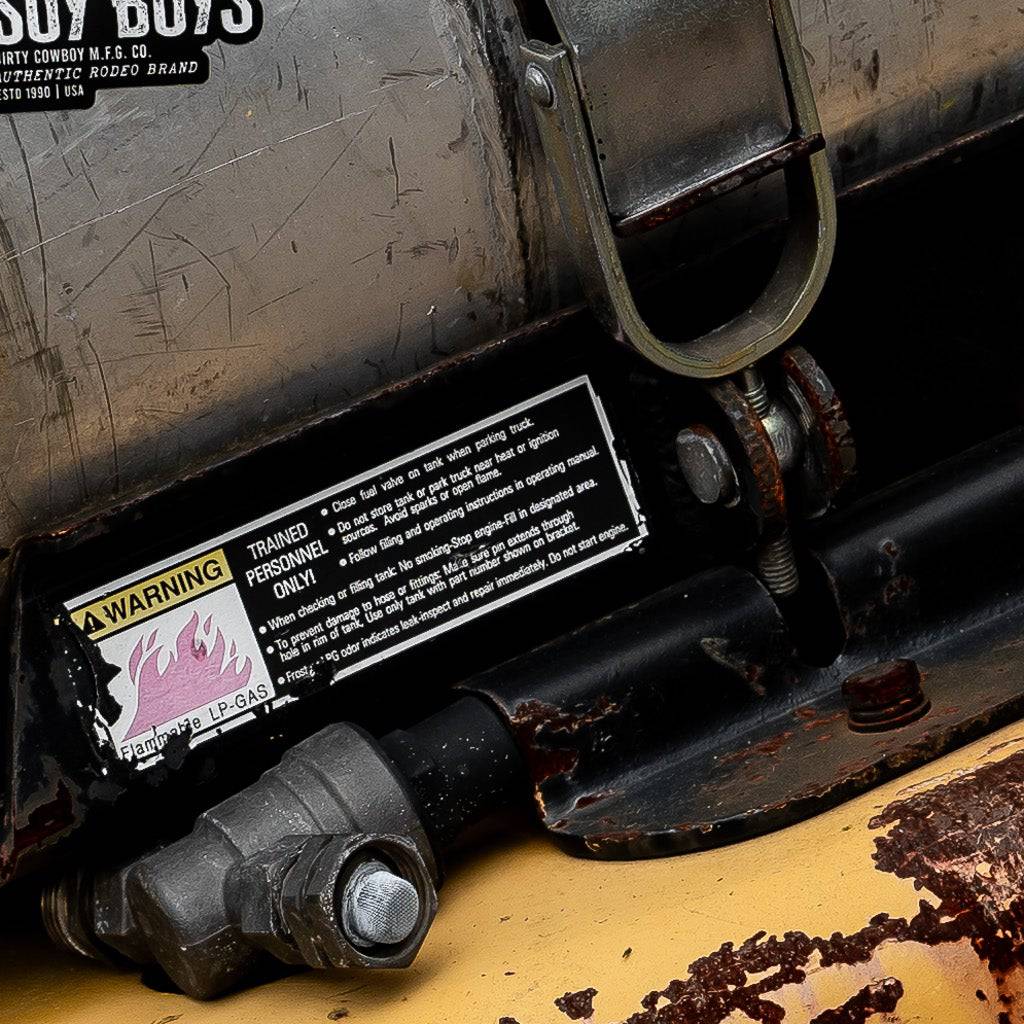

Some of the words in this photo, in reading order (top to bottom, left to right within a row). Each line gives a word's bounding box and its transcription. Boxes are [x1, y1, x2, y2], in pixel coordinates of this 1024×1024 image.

[34, 48, 84, 64] COWBOY
[89, 45, 127, 61] M.F.G.
[132, 44, 152, 59] CO.
[89, 64, 139, 79] RODEO
[147, 61, 198, 75] BRAND
[26, 85, 51, 99] 1990
[64, 84, 84, 98] USA
[332, 497, 356, 512] Close
[360, 485, 377, 500] fuel
[381, 476, 404, 490] valve
[408, 469, 420, 479] on
[424, 457, 444, 472] tank
[447, 446, 471, 461] when
[476, 431, 506, 451] parking
[510, 418, 534, 434] truck.
[337, 522, 351, 532] Do
[354, 513, 369, 526] not
[371, 503, 392, 519] store
[395, 492, 414, 509] tank
[417, 488, 428, 498] or
[429, 477, 448, 495] park
[450, 467, 472, 483] truck
[474, 458, 492, 476] near
[495, 448, 515, 463] heat
[517, 444, 525, 453] or
[528, 430, 559, 449] ignition
[349, 546, 377, 563] Follow
[380, 535, 403, 550] filling
[405, 524, 421, 539] and
[424, 507, 464, 530] operating
[465, 486, 513, 511] instructions
[515, 480, 524, 490] in
[526, 462, 565, 485] operating
[567, 446, 599, 466] manual.
[384, 507, 408, 526] Avoid
[410, 494, 438, 514] sparks
[440, 491, 449, 500] or
[452, 481, 474, 495] open
[475, 469, 501, 484] flame.
[246, 540, 328, 586] PERSONNEL
[247, 523, 308, 559] TRAINED
[267, 613, 295, 630] When
[298, 595, 336, 617] checking
[338, 589, 347, 599] or
[350, 578, 374, 594] filling
[398, 560, 413, 571] No
[416, 534, 472, 564] smoking-Stop
[518, 509, 528, 519] in
[530, 486, 574, 513] designated
[576, 479, 597, 493] area.
[102, 559, 224, 623] WARNING
[274, 639, 290, 653] To
[291, 623, 324, 646] prevent
[326, 607, 360, 629] damage
[362, 602, 372, 615] to
[373, 592, 396, 606] hose
[398, 586, 406, 596] or
[443, 558, 468, 575] Make
[470, 549, 490, 563] sure
[492, 542, 508, 556] pin
[507, 526, 540, 546] extends
[541, 510, 574, 533] through
[274, 569, 316, 598] ONLY!
[280, 646, 299, 662] hole
[301, 643, 311, 652] in
[313, 635, 327, 647] rim
[330, 627, 339, 639] of
[365, 610, 383, 623] Use
[386, 600, 403, 614] only
[405, 590, 425, 605] tank
[427, 581, 447, 595] with
[449, 571, 467, 588] part
[469, 555, 500, 576] number
[503, 544, 531, 561] shown
[533, 538, 545, 548] on
[545, 521, 579, 542] bracket.
[341, 642, 359, 657] odor
[361, 625, 400, 647] indicates
[400, 601, 451, 629] leak-inspect
[453, 592, 469, 606] and
[470, 582, 494, 599] repair
[495, 560, 548, 587] immediately.
[548, 553, 561, 563] Do
[563, 545, 577, 557] not
[578, 536, 597, 550] start
[599, 524, 628, 541] engine.
[208, 684, 269, 722] LP-GAS
